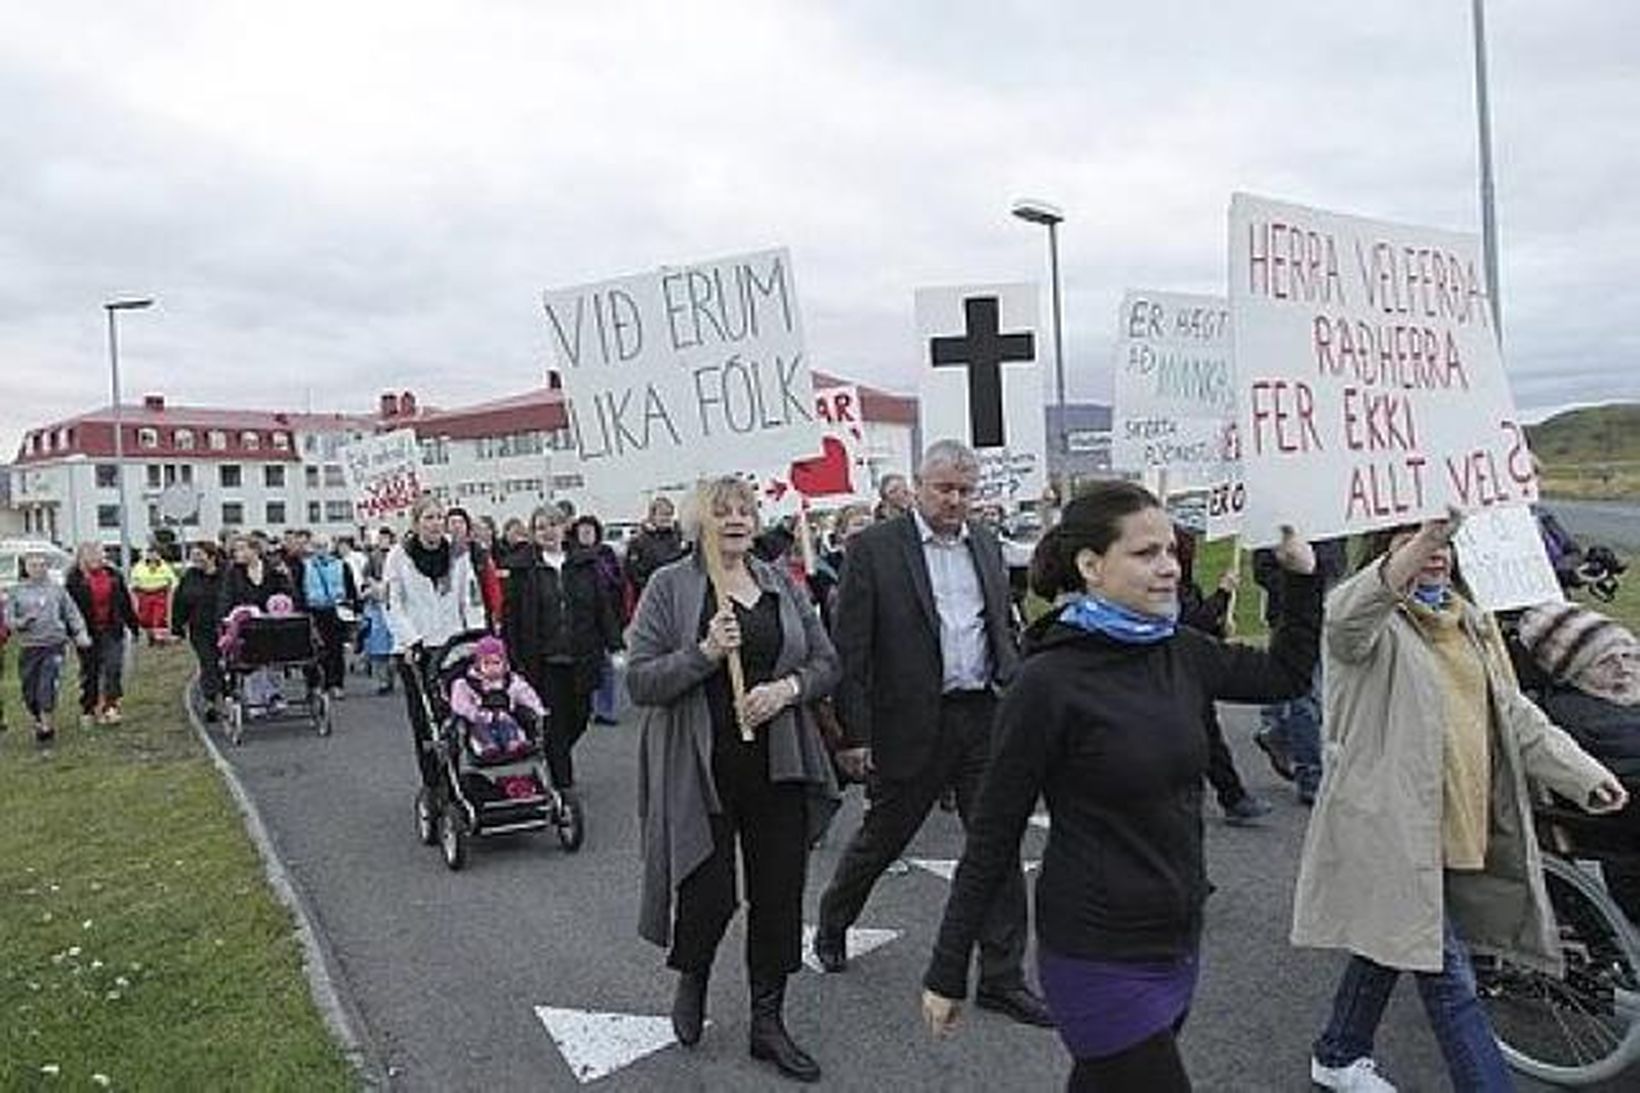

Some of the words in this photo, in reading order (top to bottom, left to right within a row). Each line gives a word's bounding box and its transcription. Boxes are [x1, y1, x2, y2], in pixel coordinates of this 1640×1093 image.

[1249, 223, 1343, 303] HERRA
[545, 290, 642, 368] VIÐ
[663, 257, 792, 350] ERUM
[568, 382, 682, 461] LIKA
[694, 354, 813, 436] FÓLK
[1252, 381, 1323, 455] FER
[1344, 388, 1417, 452] EKKI
[1346, 460, 1425, 520] ALLT
